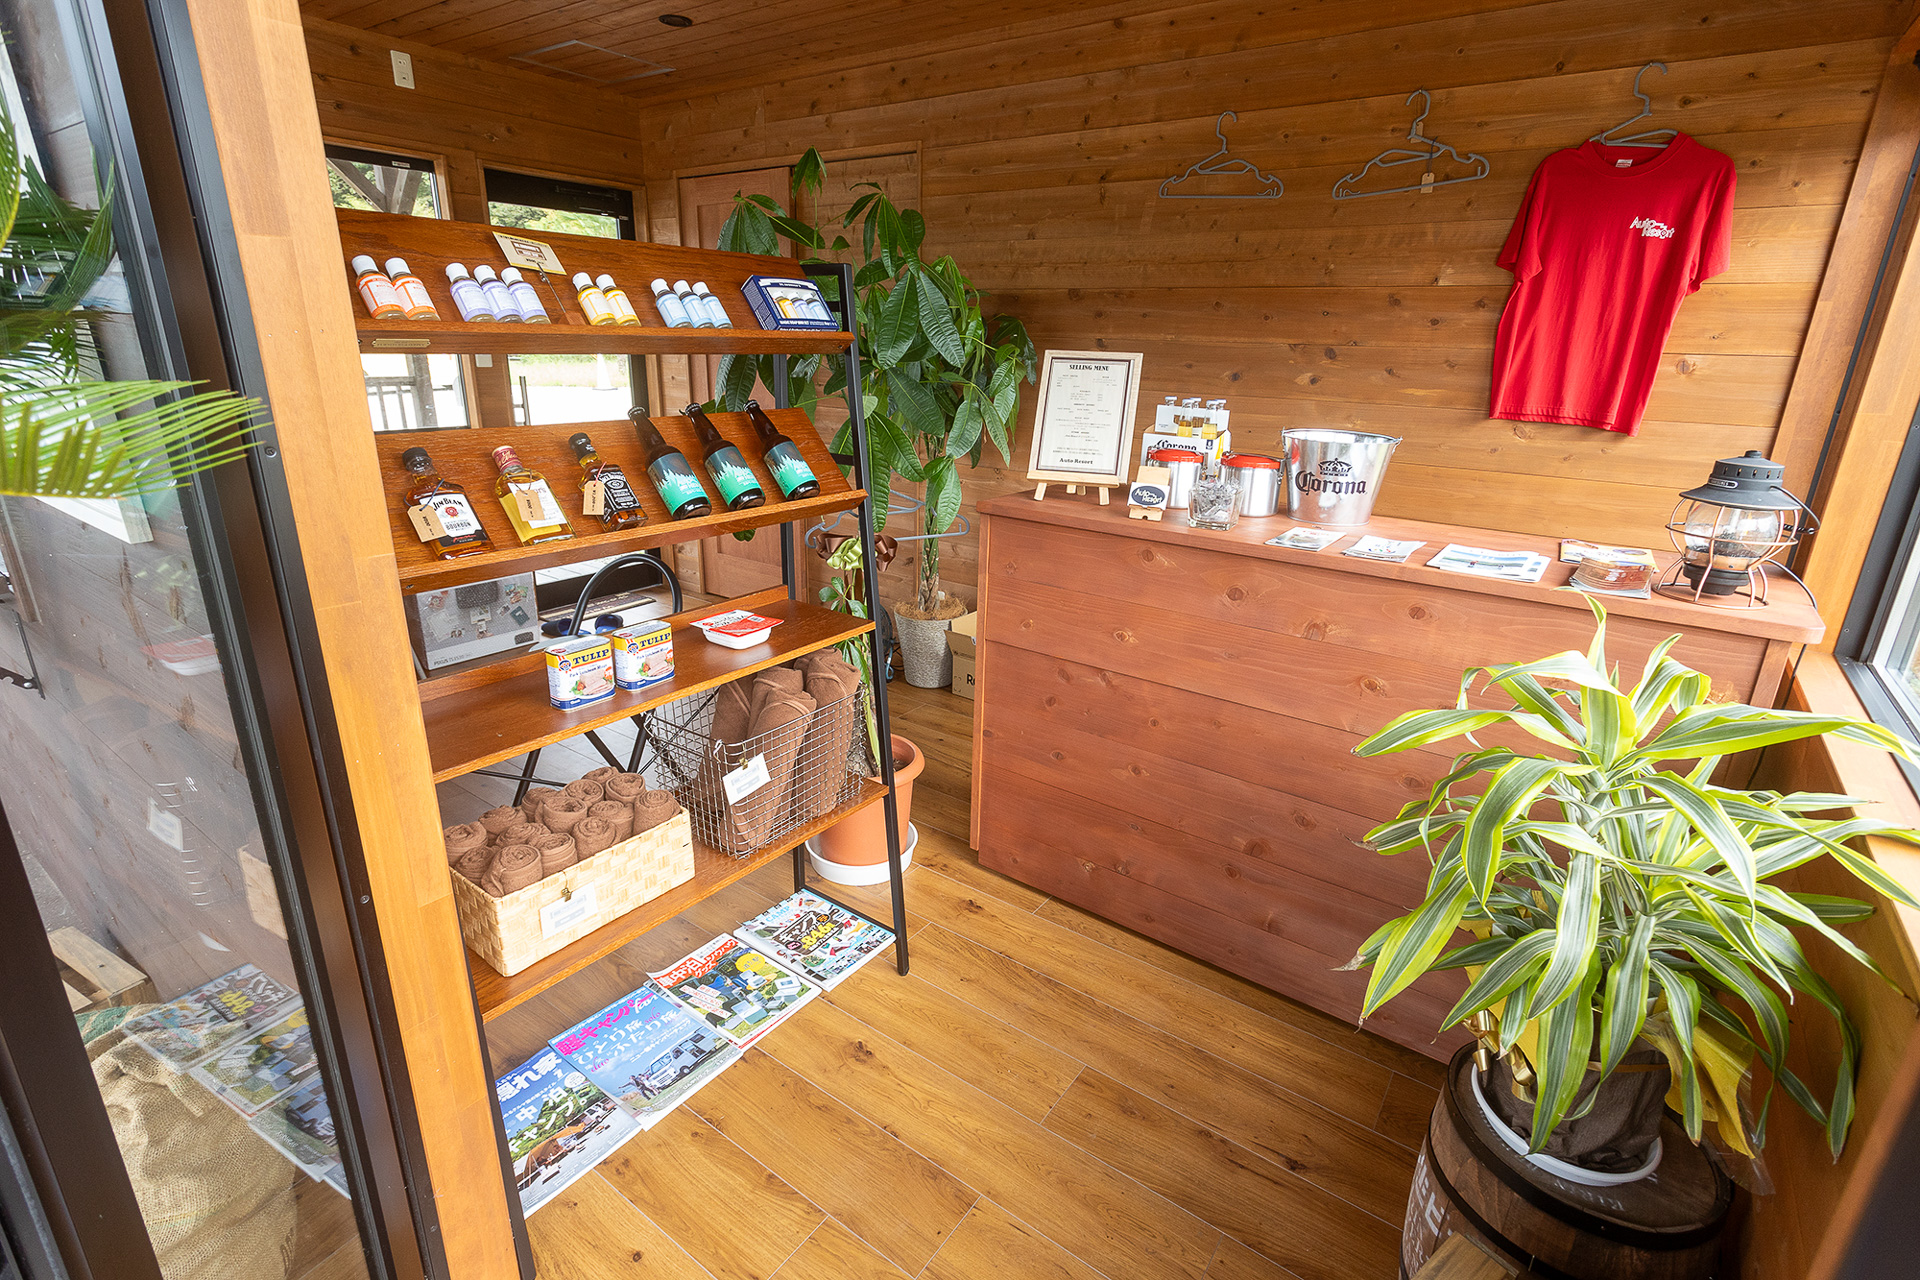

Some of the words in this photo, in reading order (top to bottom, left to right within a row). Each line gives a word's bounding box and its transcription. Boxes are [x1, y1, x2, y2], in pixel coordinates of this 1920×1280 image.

[1629, 216, 1657, 229] Auto
[1641, 226, 1675, 239] Resort
[1295, 470, 1367, 496] Corona
[1134, 488, 1151, 497] Auto
[443, 497, 465, 508] BEAM
[640, 632, 670, 648] TULIP
[573, 649, 609, 665] TULIP
[765, 905, 791, 923] CAMP
[633, 994, 659, 1014] fan
[644, 1007, 661, 1024] solo
[613, 1009, 679, 1057] ふたり旅
